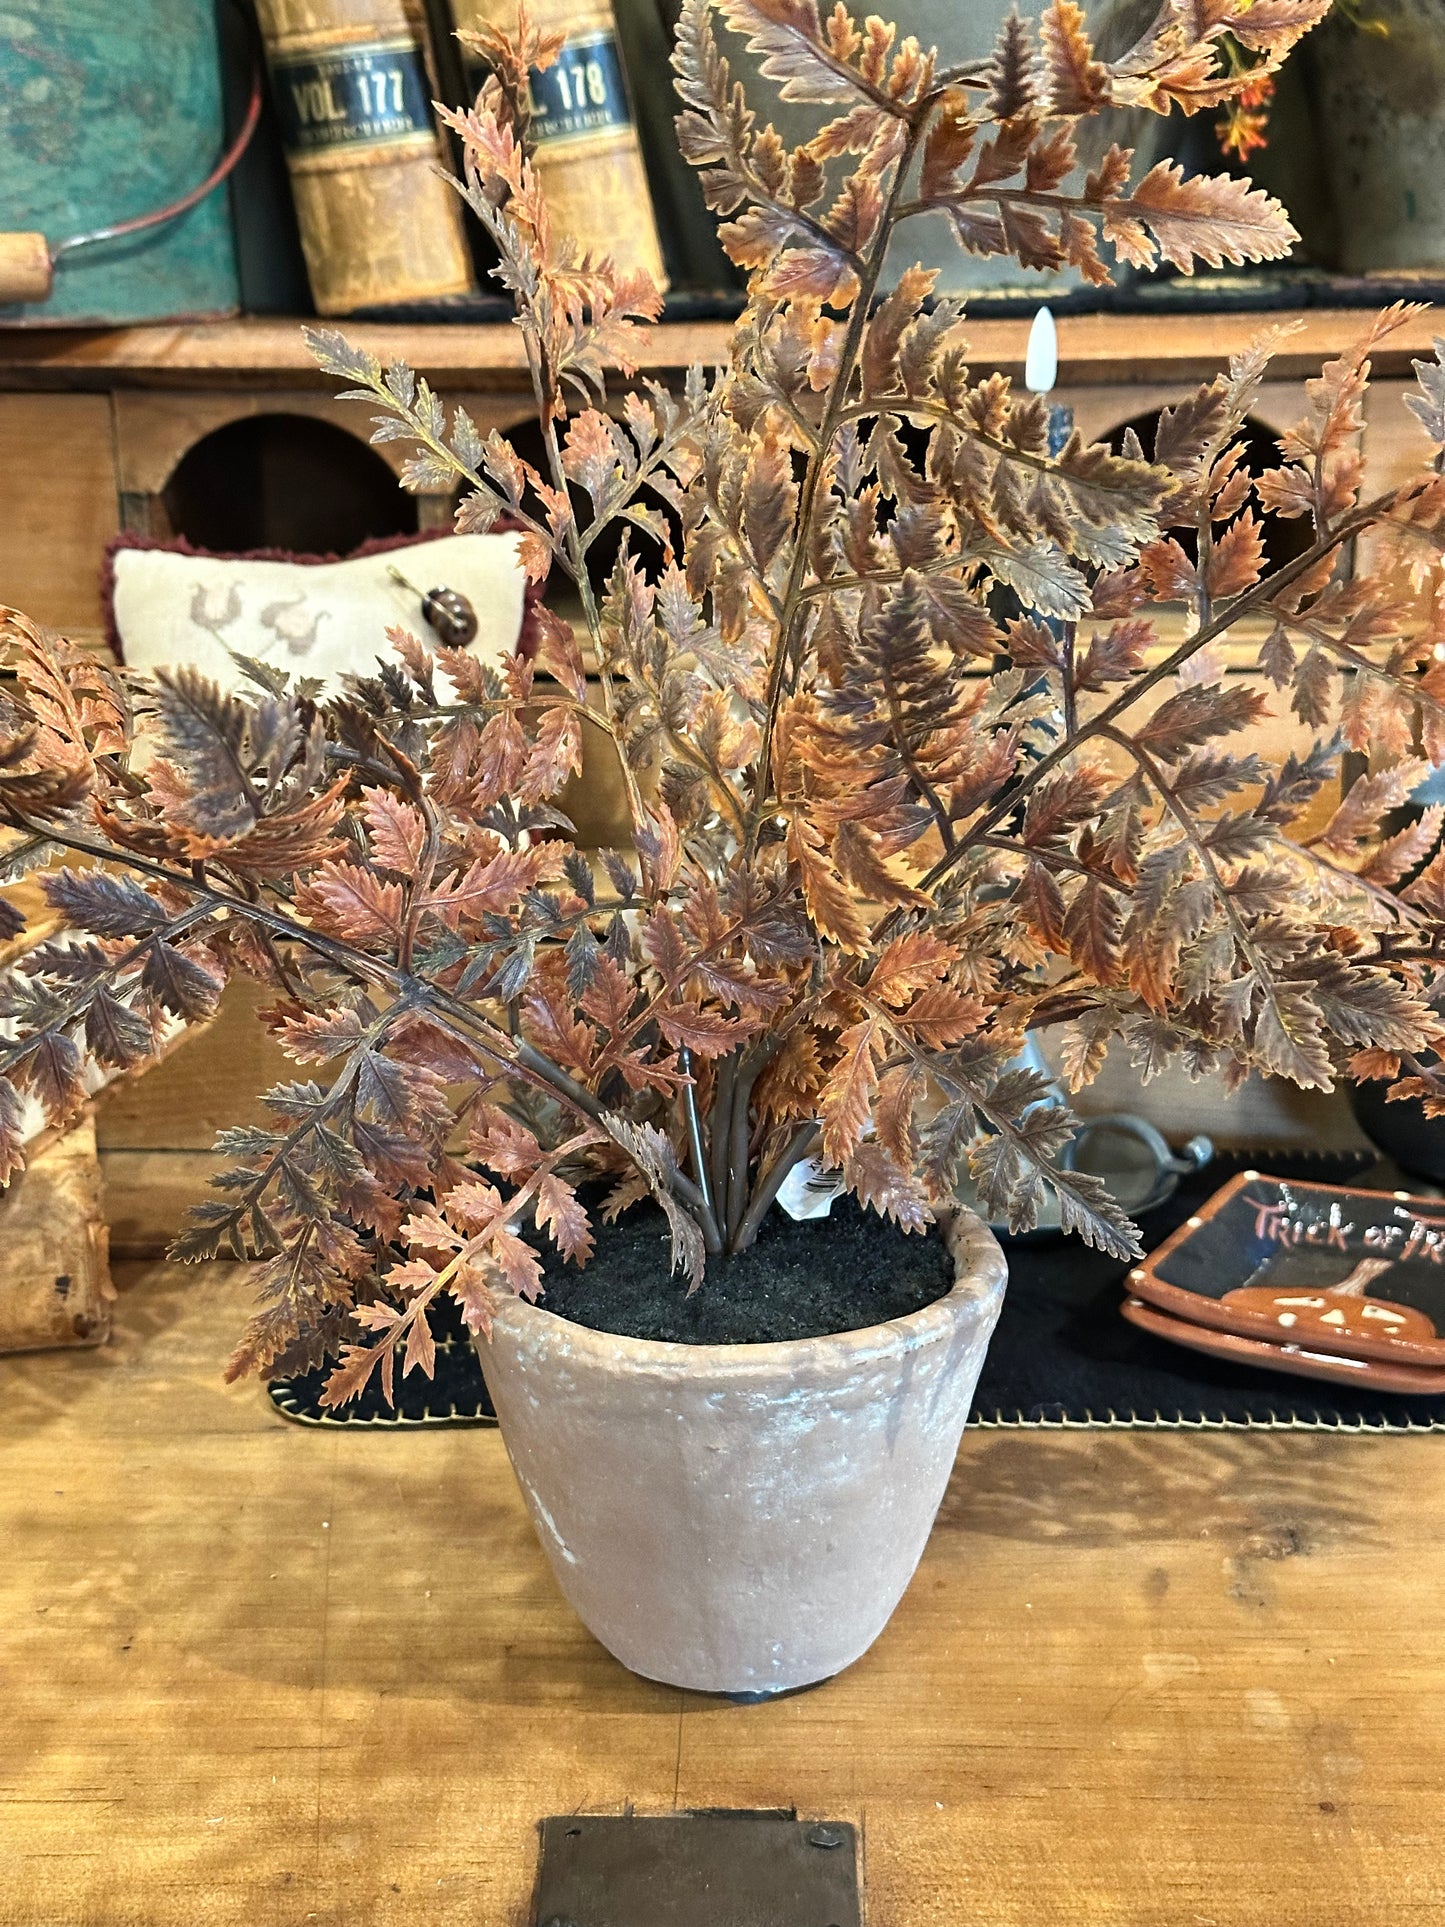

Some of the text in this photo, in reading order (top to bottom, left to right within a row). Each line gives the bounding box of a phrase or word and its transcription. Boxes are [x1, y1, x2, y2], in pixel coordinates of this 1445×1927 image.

[290, 67, 405, 124] VOL. 177
[556, 60, 608, 111] 178
